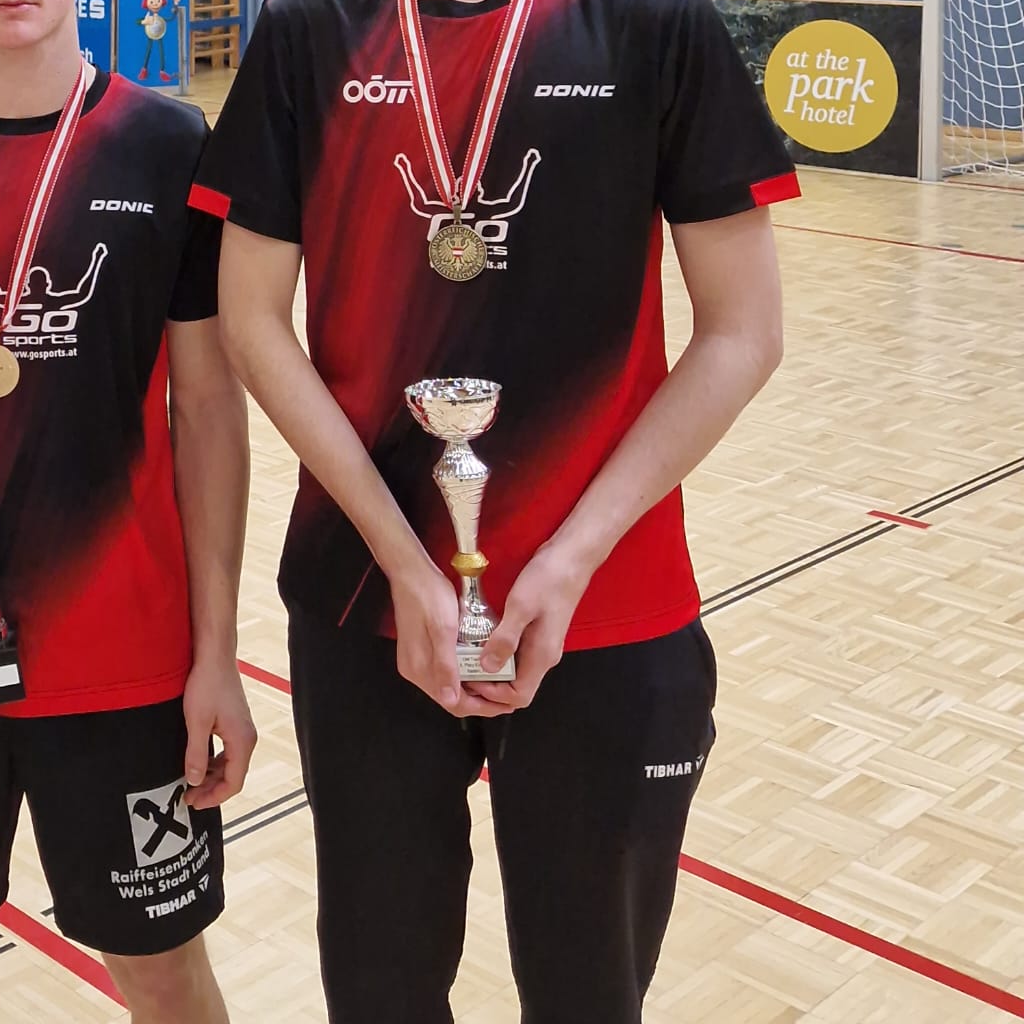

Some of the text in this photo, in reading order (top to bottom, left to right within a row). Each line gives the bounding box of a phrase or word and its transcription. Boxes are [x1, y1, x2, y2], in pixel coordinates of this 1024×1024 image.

[786, 49, 850, 71] at the
[534, 84, 616, 97] DONIC
[783, 58, 875, 113] park
[800, 100, 856, 126] hotel
[89, 199, 154, 214] DONIC
[2, 334, 78, 347] sports
[11, 348, 78, 360] ww.gosports.at
[644, 761, 692, 778] TIBHAR
[110, 830, 209, 884] Raiffeisenbanken
[118, 844, 210, 899] Wels Stadt Land
[145, 889, 197, 919] TIBHAR
